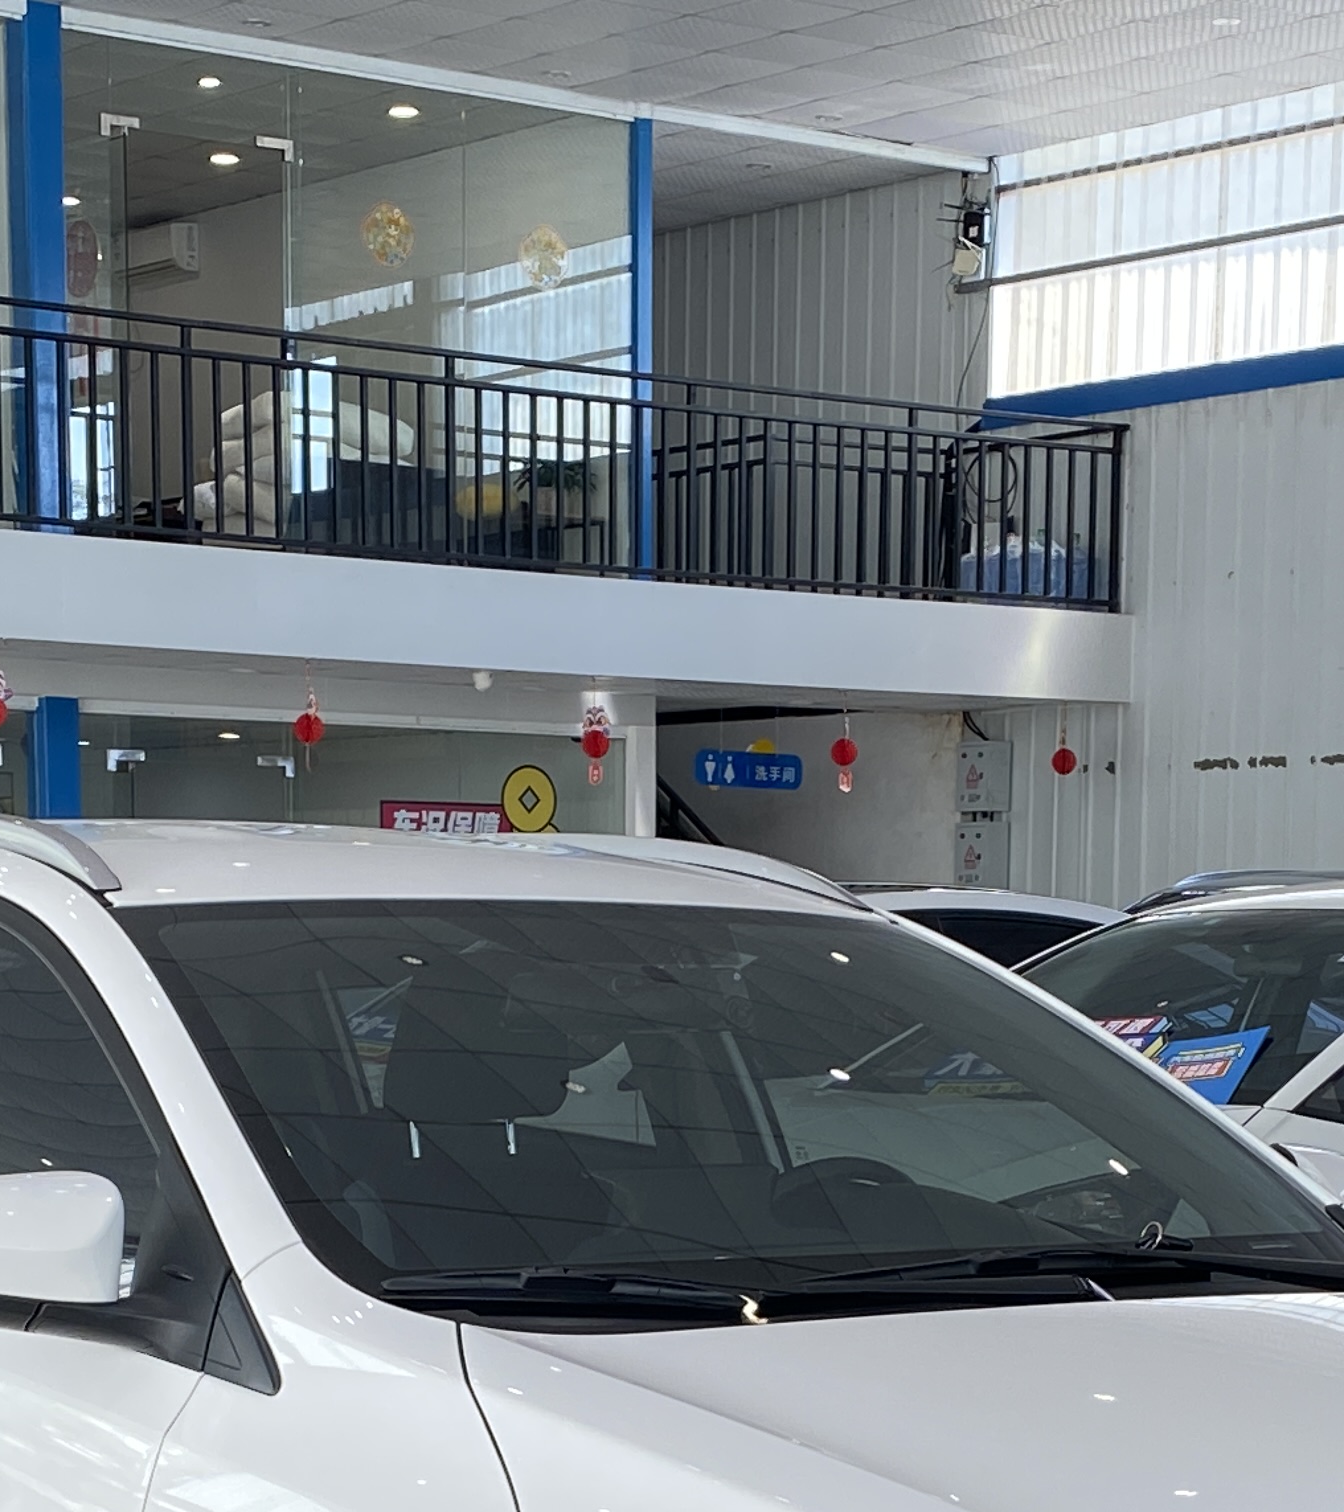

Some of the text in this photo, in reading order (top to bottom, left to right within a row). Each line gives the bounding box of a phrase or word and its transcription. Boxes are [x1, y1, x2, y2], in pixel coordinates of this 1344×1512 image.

[755, 765, 796, 783] 洗手间
[393, 809, 501, 834] 车况保障
